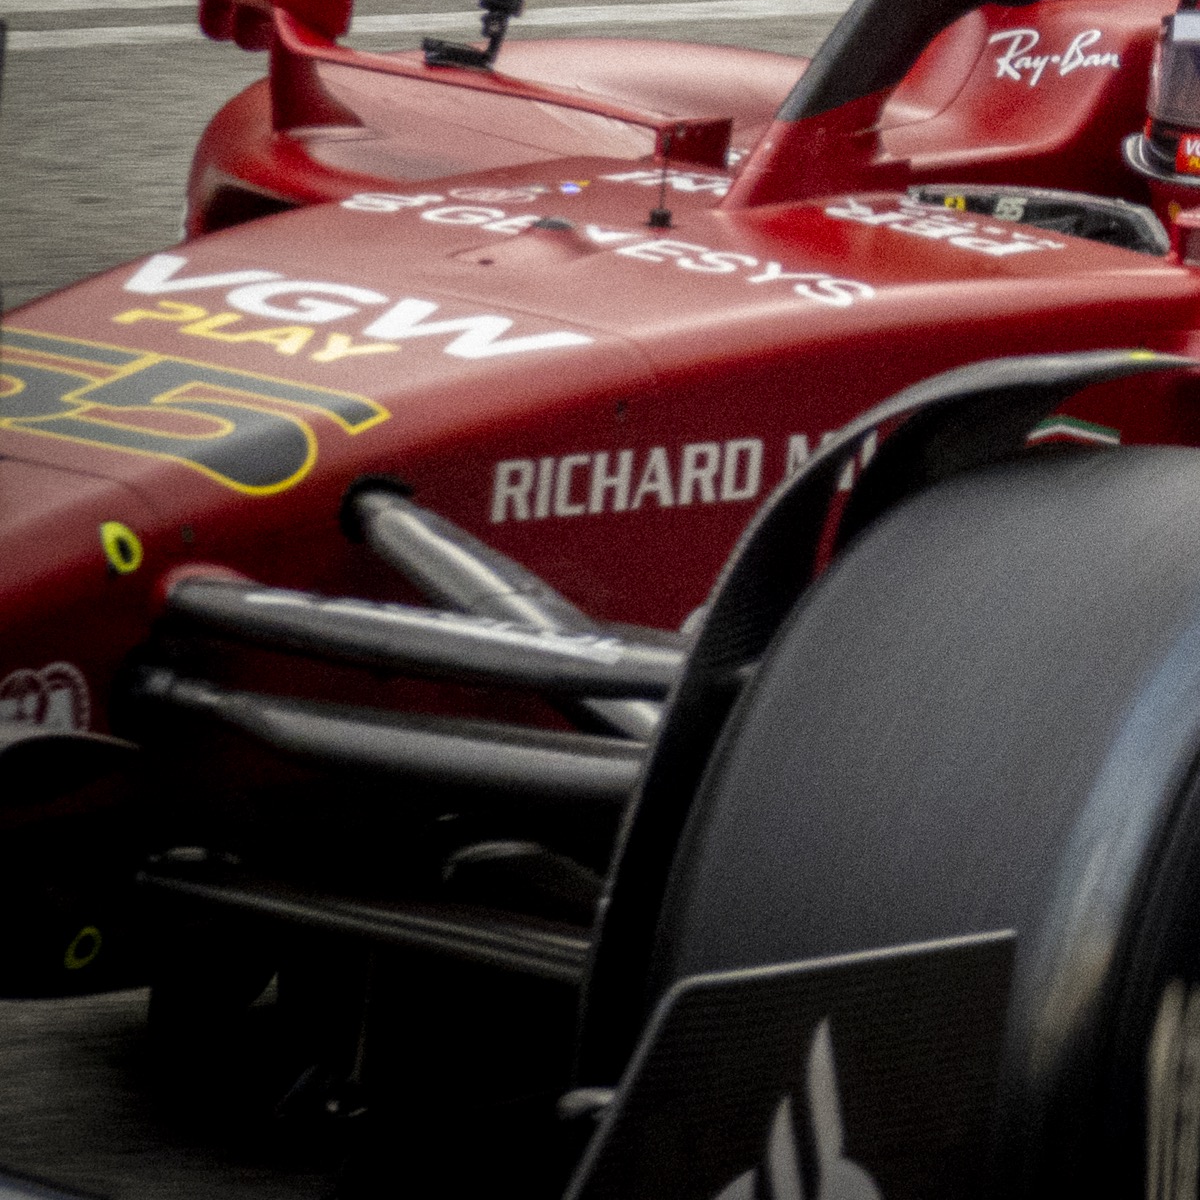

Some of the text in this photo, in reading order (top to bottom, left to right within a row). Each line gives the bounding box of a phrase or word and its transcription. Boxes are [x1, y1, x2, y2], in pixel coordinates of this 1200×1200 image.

[988, 29, 1121, 88] Ray-Ban
[111, 300, 401, 363] PLAY
[123, 253, 598, 360] VGW
[490, 437, 764, 524] RICHARD
